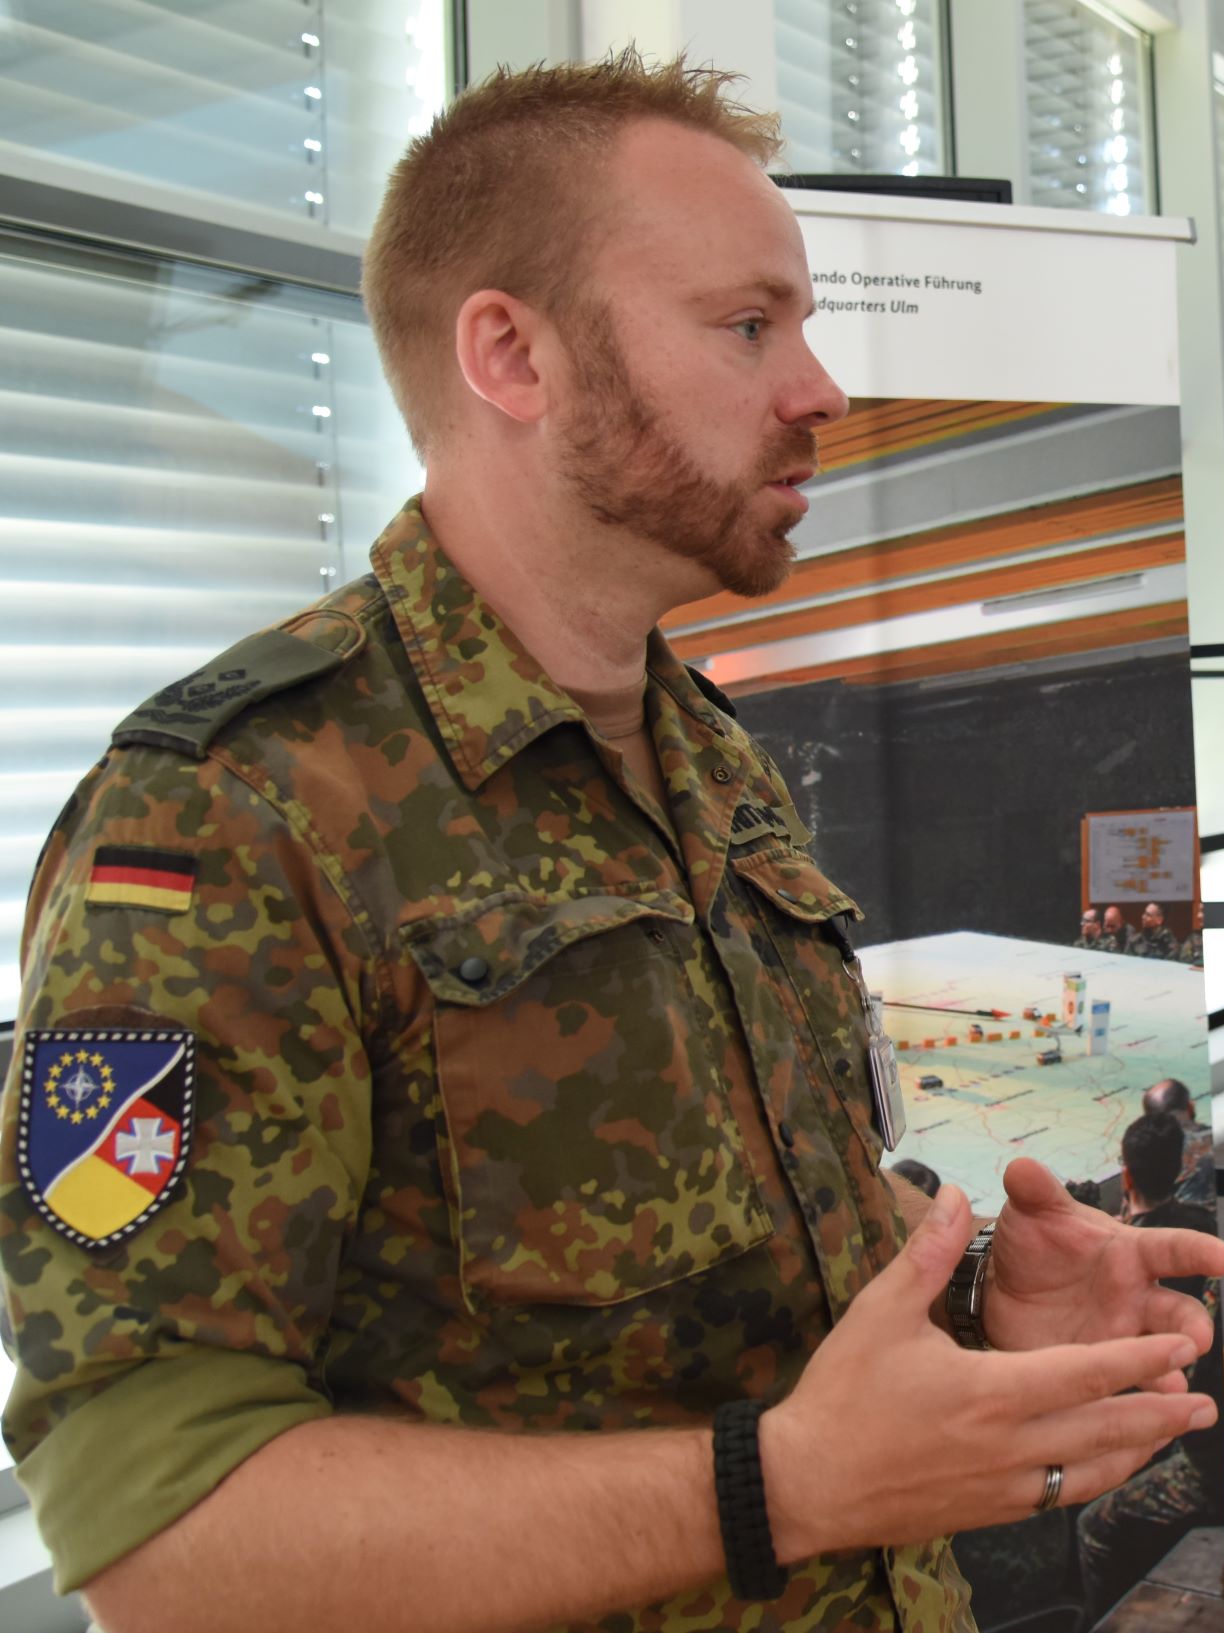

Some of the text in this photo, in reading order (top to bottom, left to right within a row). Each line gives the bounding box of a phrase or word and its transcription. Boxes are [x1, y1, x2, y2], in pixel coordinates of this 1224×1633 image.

[811, 270, 983, 295] ando Operative Führung
[890, 299, 919, 314] Ulm
